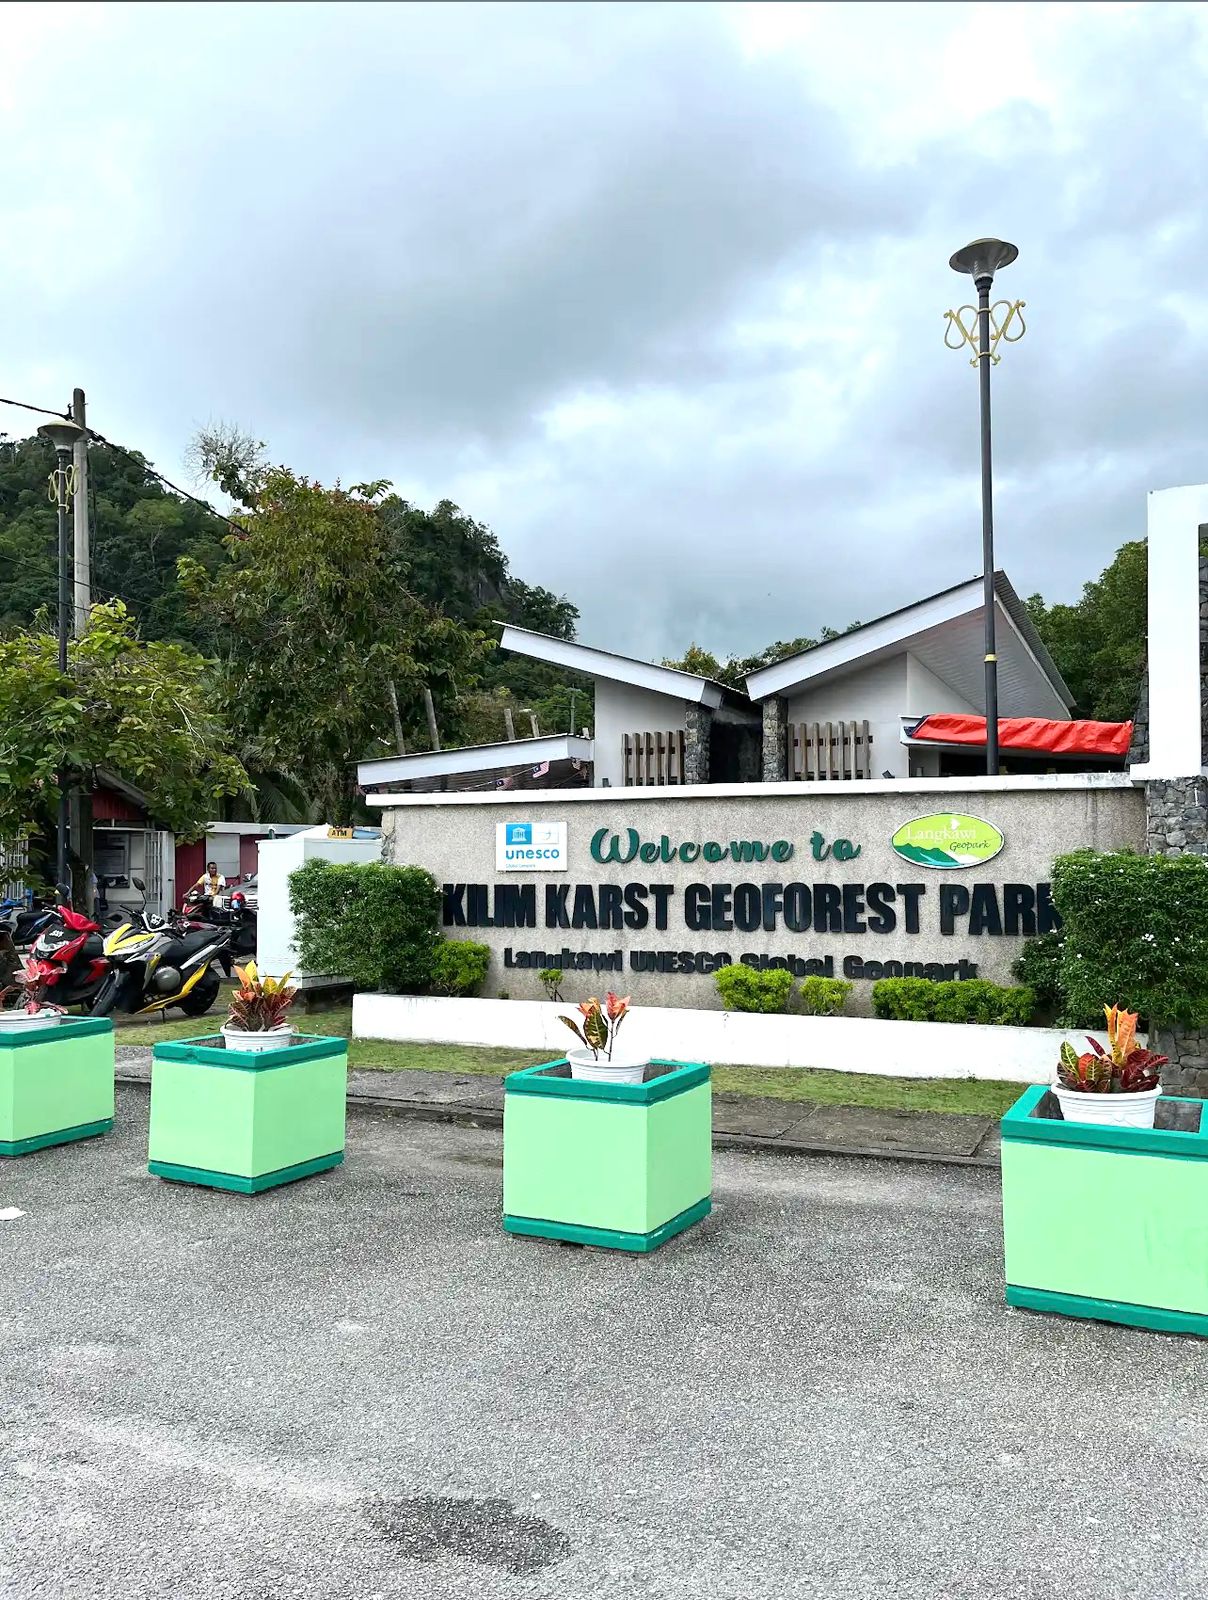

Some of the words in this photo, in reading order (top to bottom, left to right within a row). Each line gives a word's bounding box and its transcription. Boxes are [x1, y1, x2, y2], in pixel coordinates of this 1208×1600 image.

[906, 825, 977, 843] Langkawi
[505, 848, 560, 860] unesco
[590, 827, 794, 864] Welcome
[810, 830, 862, 862] to
[949, 840, 990, 852] Geopark
[442, 883, 536, 928] KILIM
[545, 882, 675, 931] KARST
[684, 882, 926, 934] GEOFOREST
